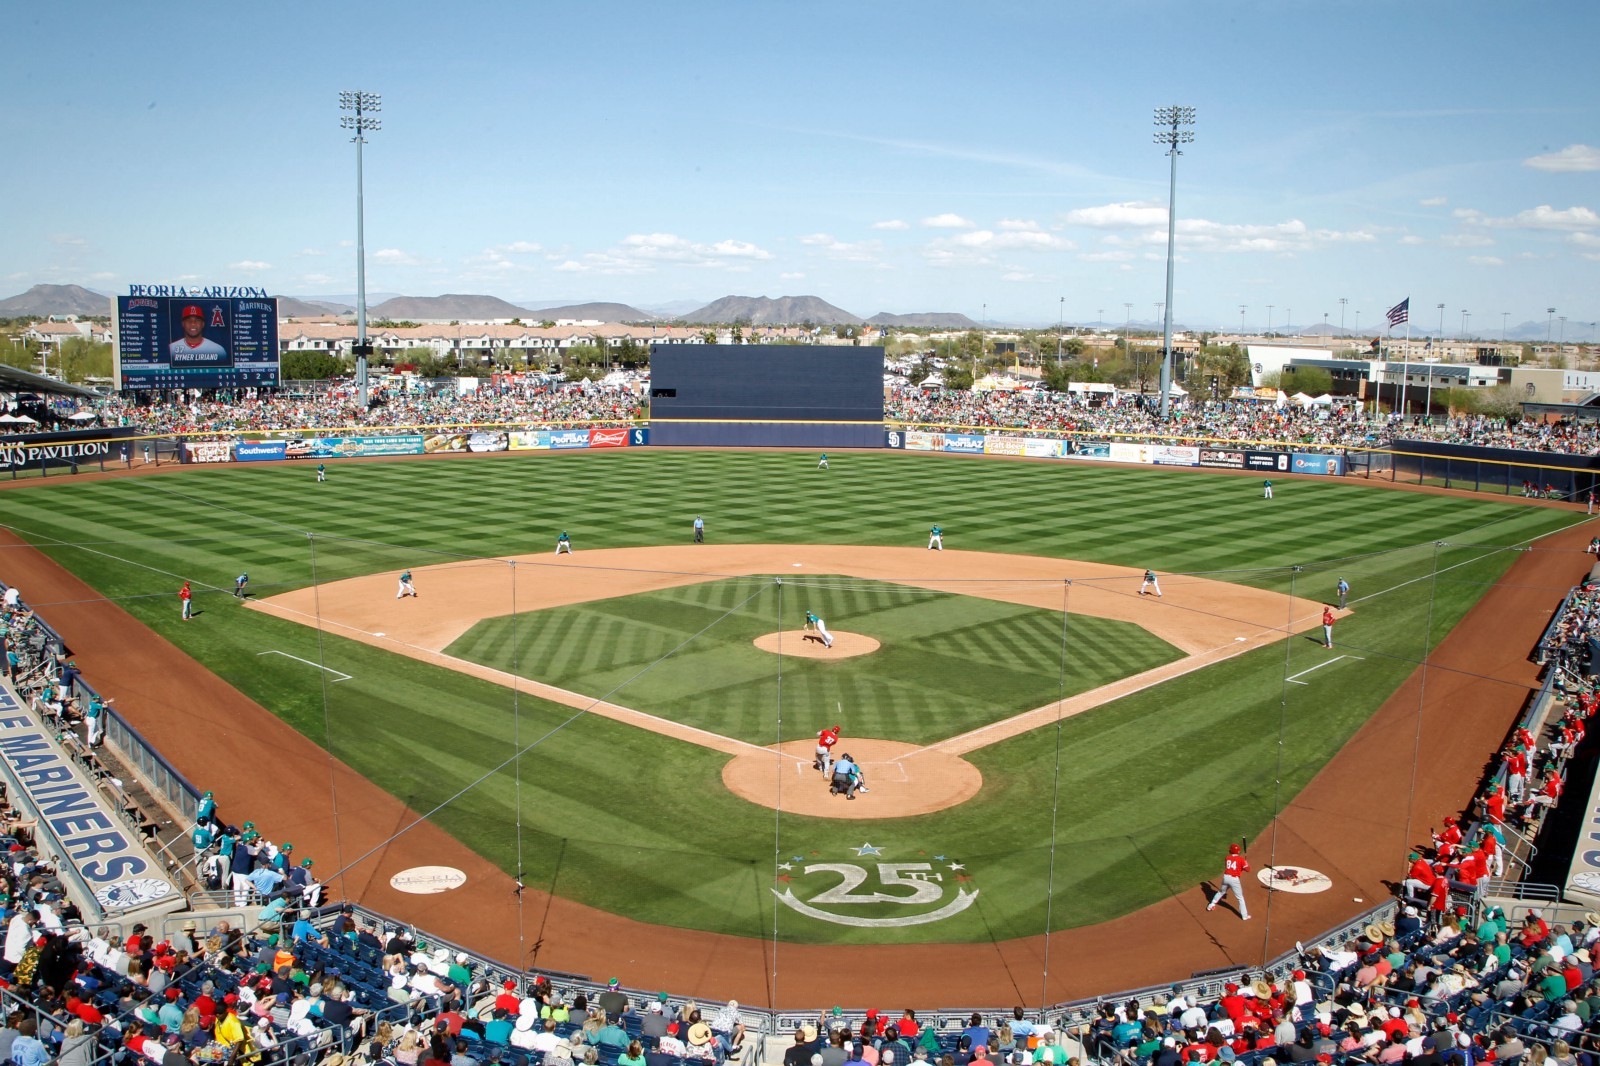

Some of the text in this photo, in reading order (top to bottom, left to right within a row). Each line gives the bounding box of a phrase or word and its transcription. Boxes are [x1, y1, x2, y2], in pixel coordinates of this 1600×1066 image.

[129, 284, 268, 298] PEORIA ARIZONA
[239, 301, 272, 312] MARINERS
[211, 305, 225, 327] A
[550, 434, 588, 444] PeoriaAZ
[635, 430, 644, 444] S
[888, 432, 900, 448] SD
[945, 438, 984, 449] PeoriaAZ
[28, 442, 109, 461] PAVILION
[239, 448, 278, 456] Southwest
[0, 733, 148, 882] MARINERS
[1226, 860, 1237, 870] 84
